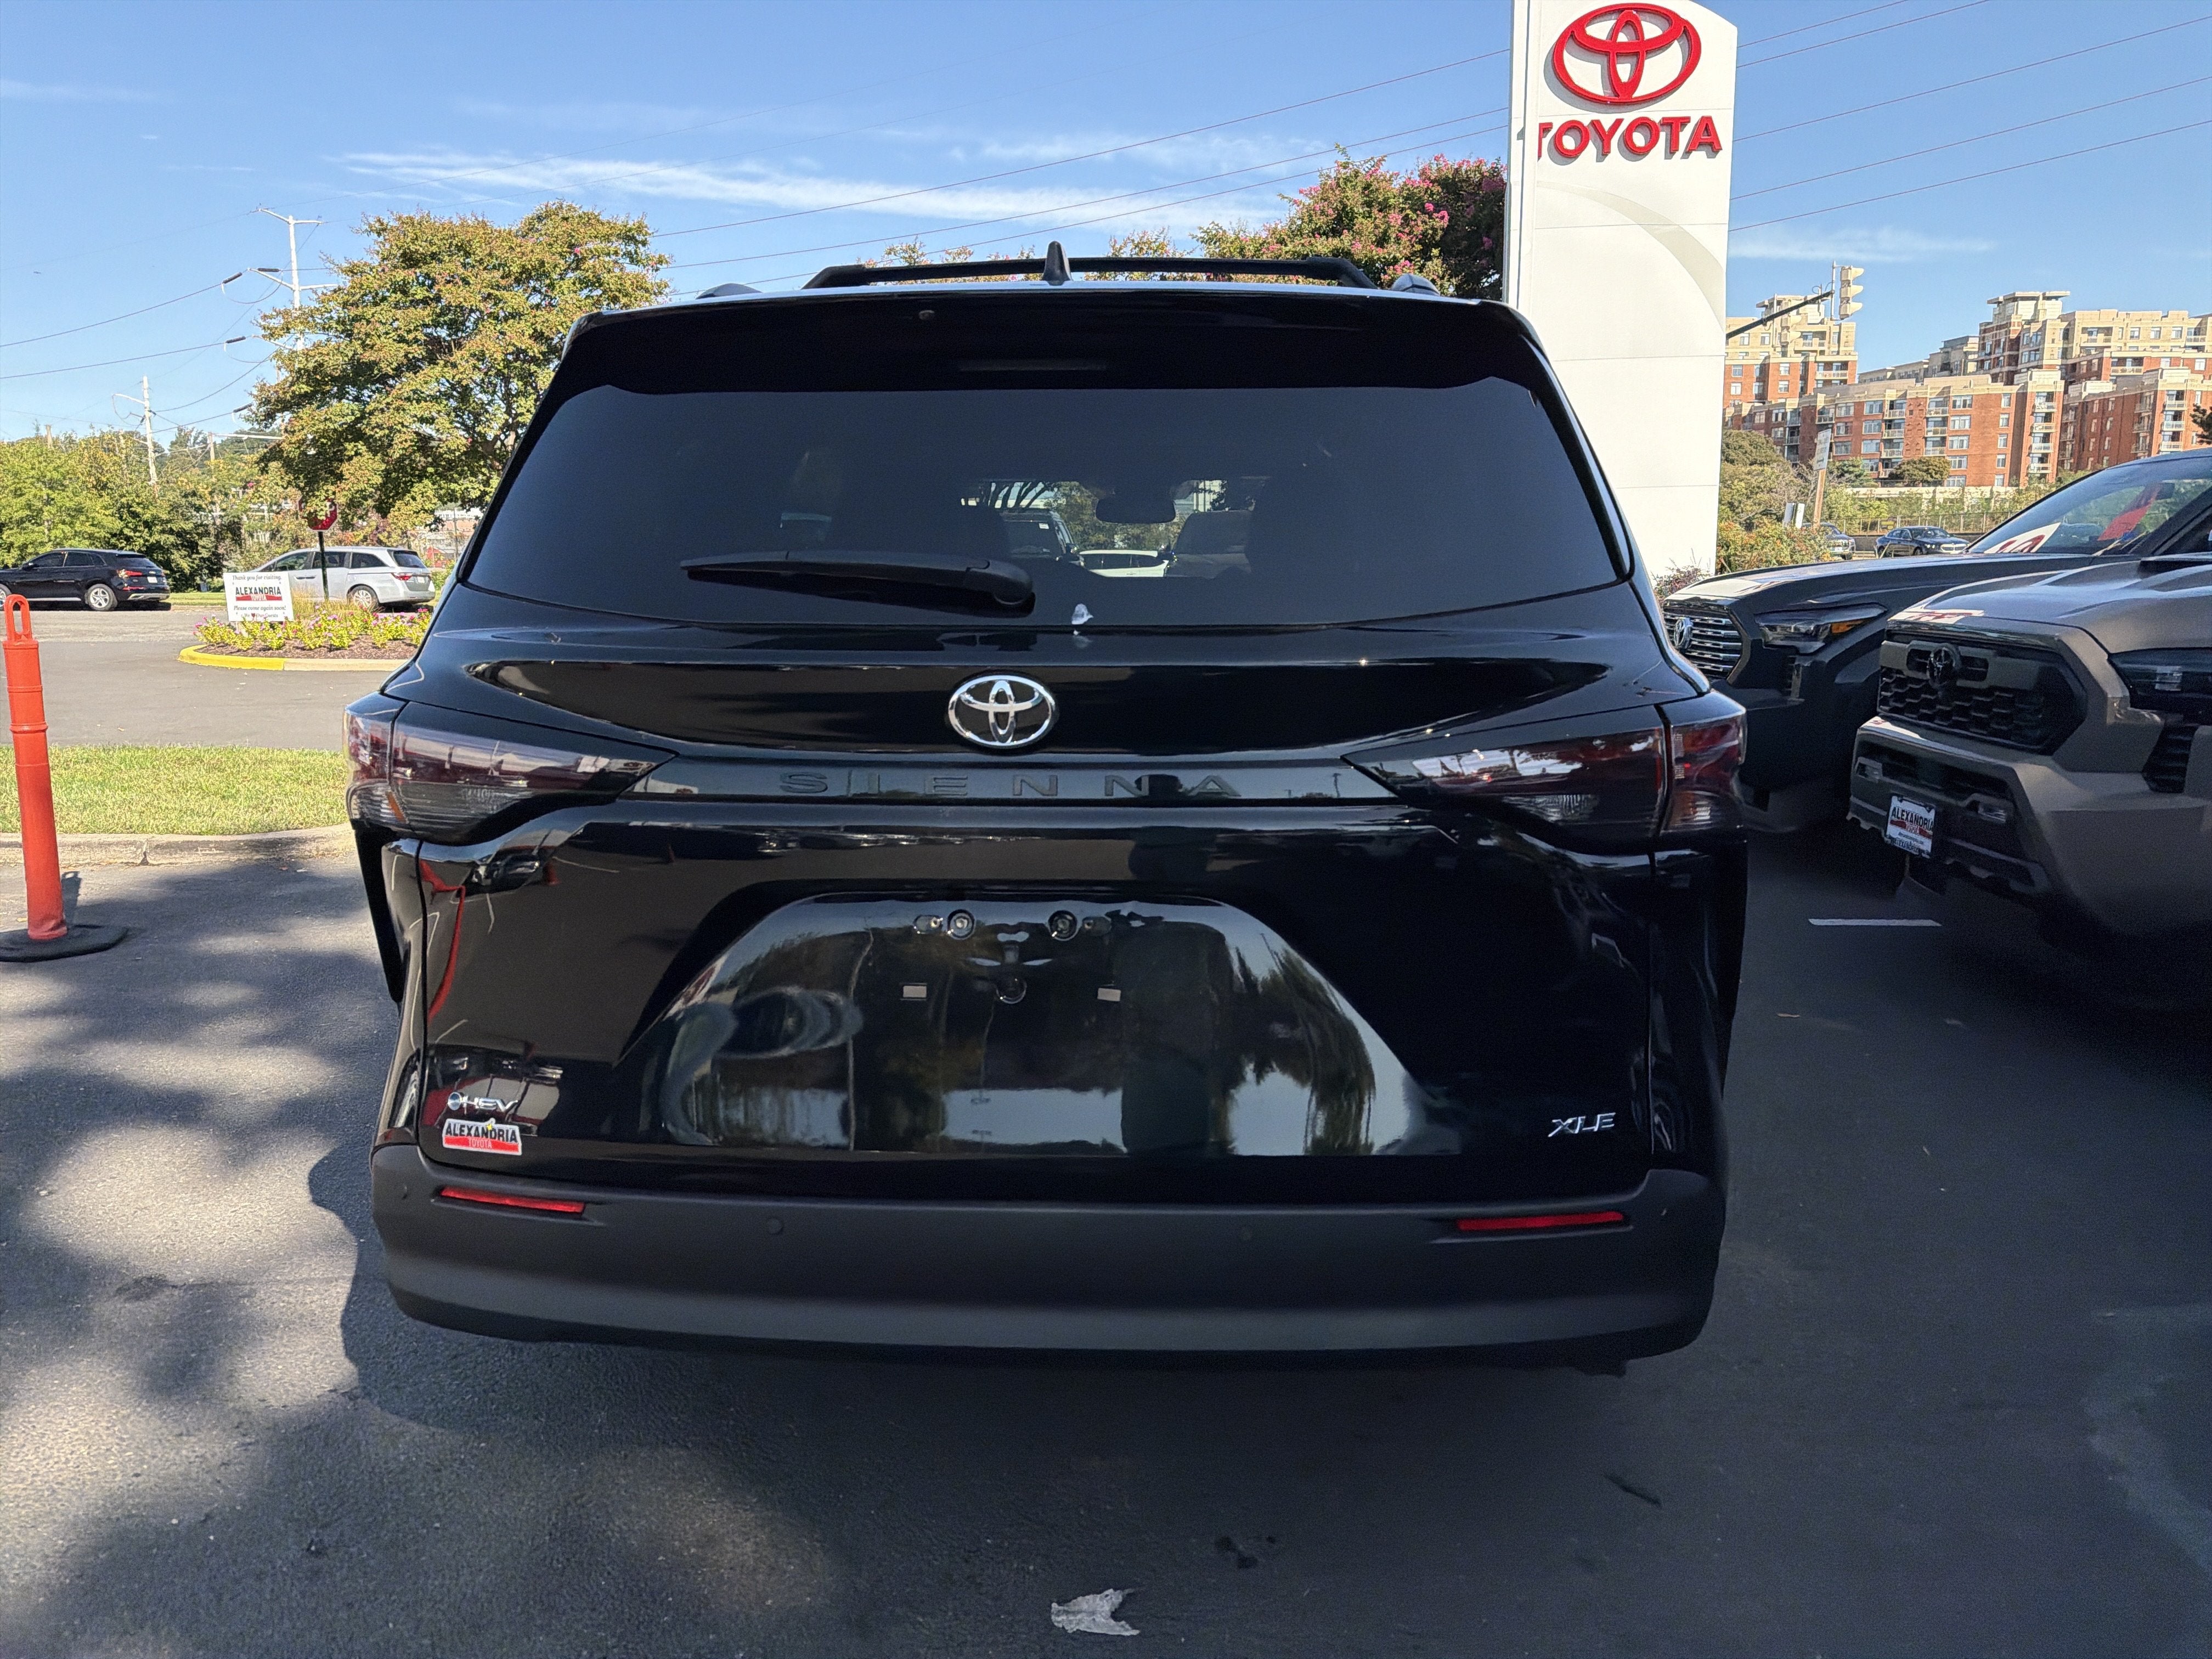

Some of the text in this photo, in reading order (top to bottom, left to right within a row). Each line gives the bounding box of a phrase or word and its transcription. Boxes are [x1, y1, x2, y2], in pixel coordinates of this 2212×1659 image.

[1538, 115, 1723, 158] TOYOTA
[235, 586, 281, 595] ALEXANDRIA
[778, 770, 1242, 797] SIENNA
[445, 1122, 517, 1143] ALEXANDRIA
[1547, 1112, 1616, 1137] XLE
[469, 1138, 493, 1149] TOYOTA
